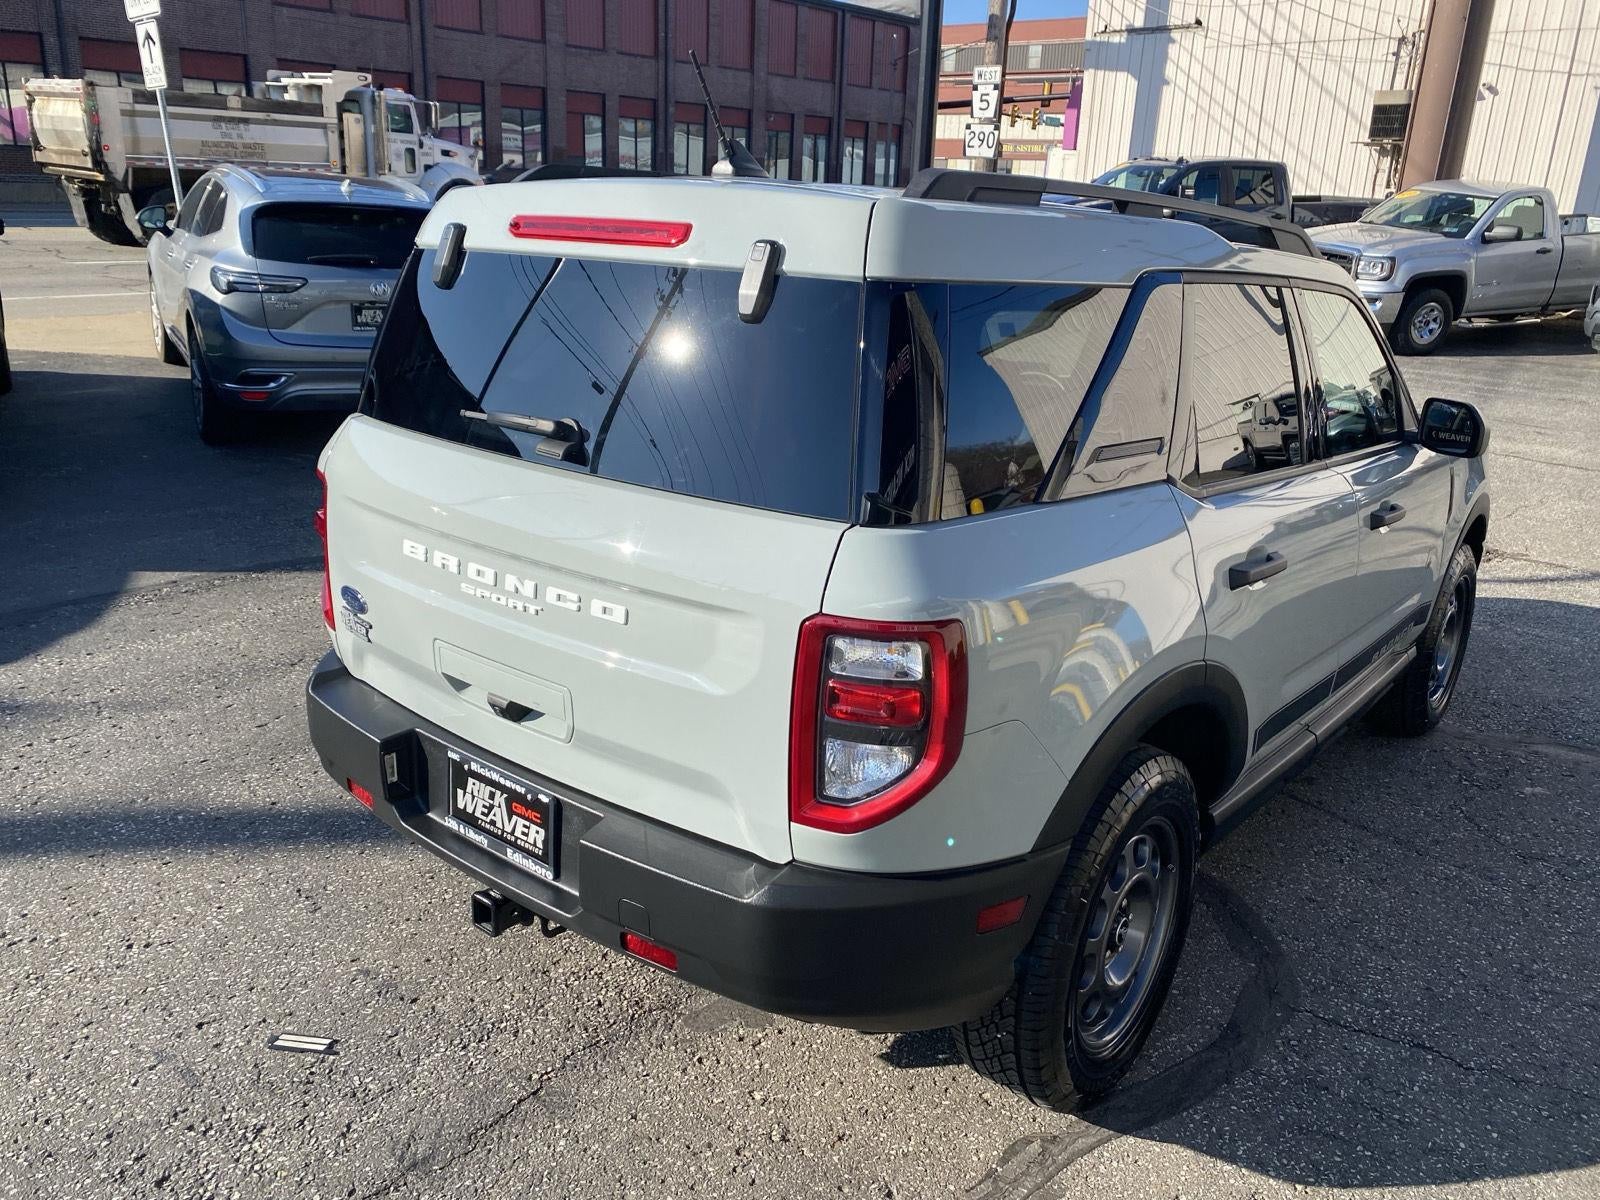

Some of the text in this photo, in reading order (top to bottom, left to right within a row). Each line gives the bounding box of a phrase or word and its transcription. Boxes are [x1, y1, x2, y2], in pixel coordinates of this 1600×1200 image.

[977, 70, 998, 81] WEST
[978, 93, 990, 111] 5
[201, 140, 264, 151] MUNICIPAL WASTE
[967, 130, 996, 149] 290
[1438, 431, 1471, 443] WEAVER
[402, 539, 629, 626] BRONCO
[460, 582, 544, 616] SPORT
[466, 776, 508, 807] RICK
[457, 787, 546, 850] WEAVER
[511, 802, 541, 824] GMC
[477, 819, 543, 856] FAMOUS FOR SERVICE
[506, 847, 554, 880] Edinboro
